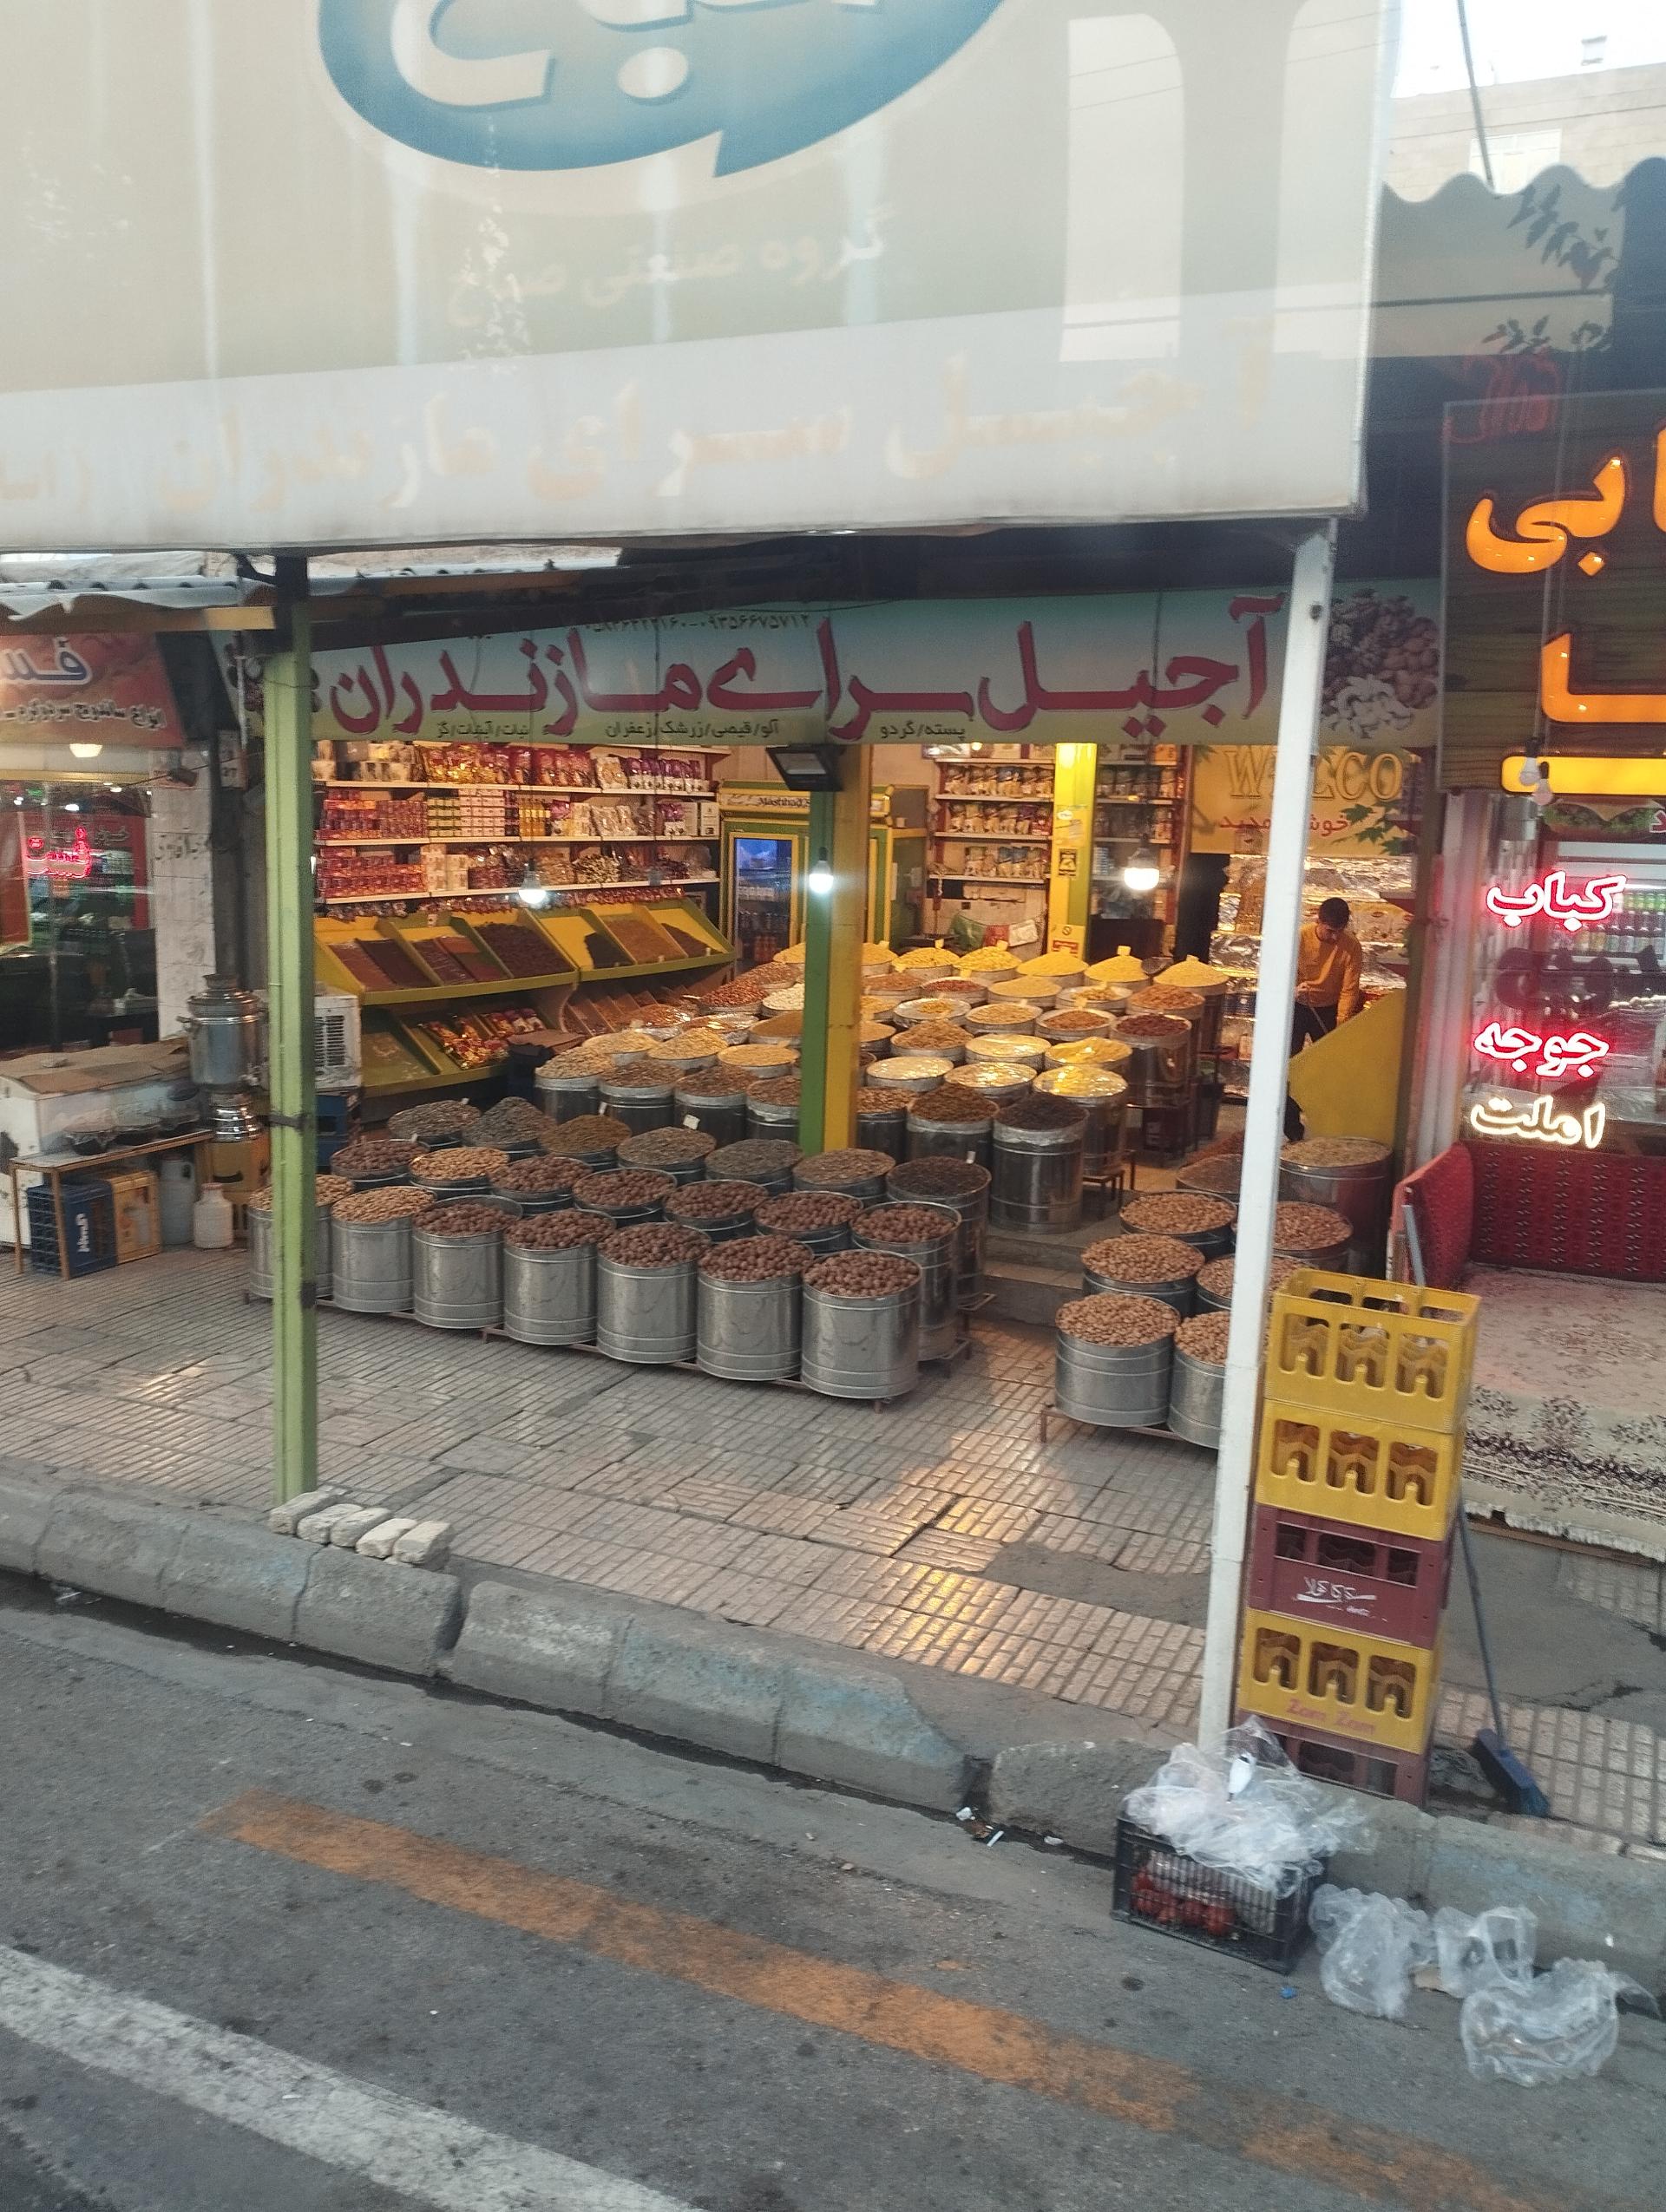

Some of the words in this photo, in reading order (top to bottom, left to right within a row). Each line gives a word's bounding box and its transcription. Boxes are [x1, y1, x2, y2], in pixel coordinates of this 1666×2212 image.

[330, 625, 703, 736] مازندران
[977, 592, 1288, 739] آجیل
[1486, 870, 1626, 933] کباب
[1474, 1020, 1610, 1077] جوجه
[1471, 1095, 1606, 1151] املت
